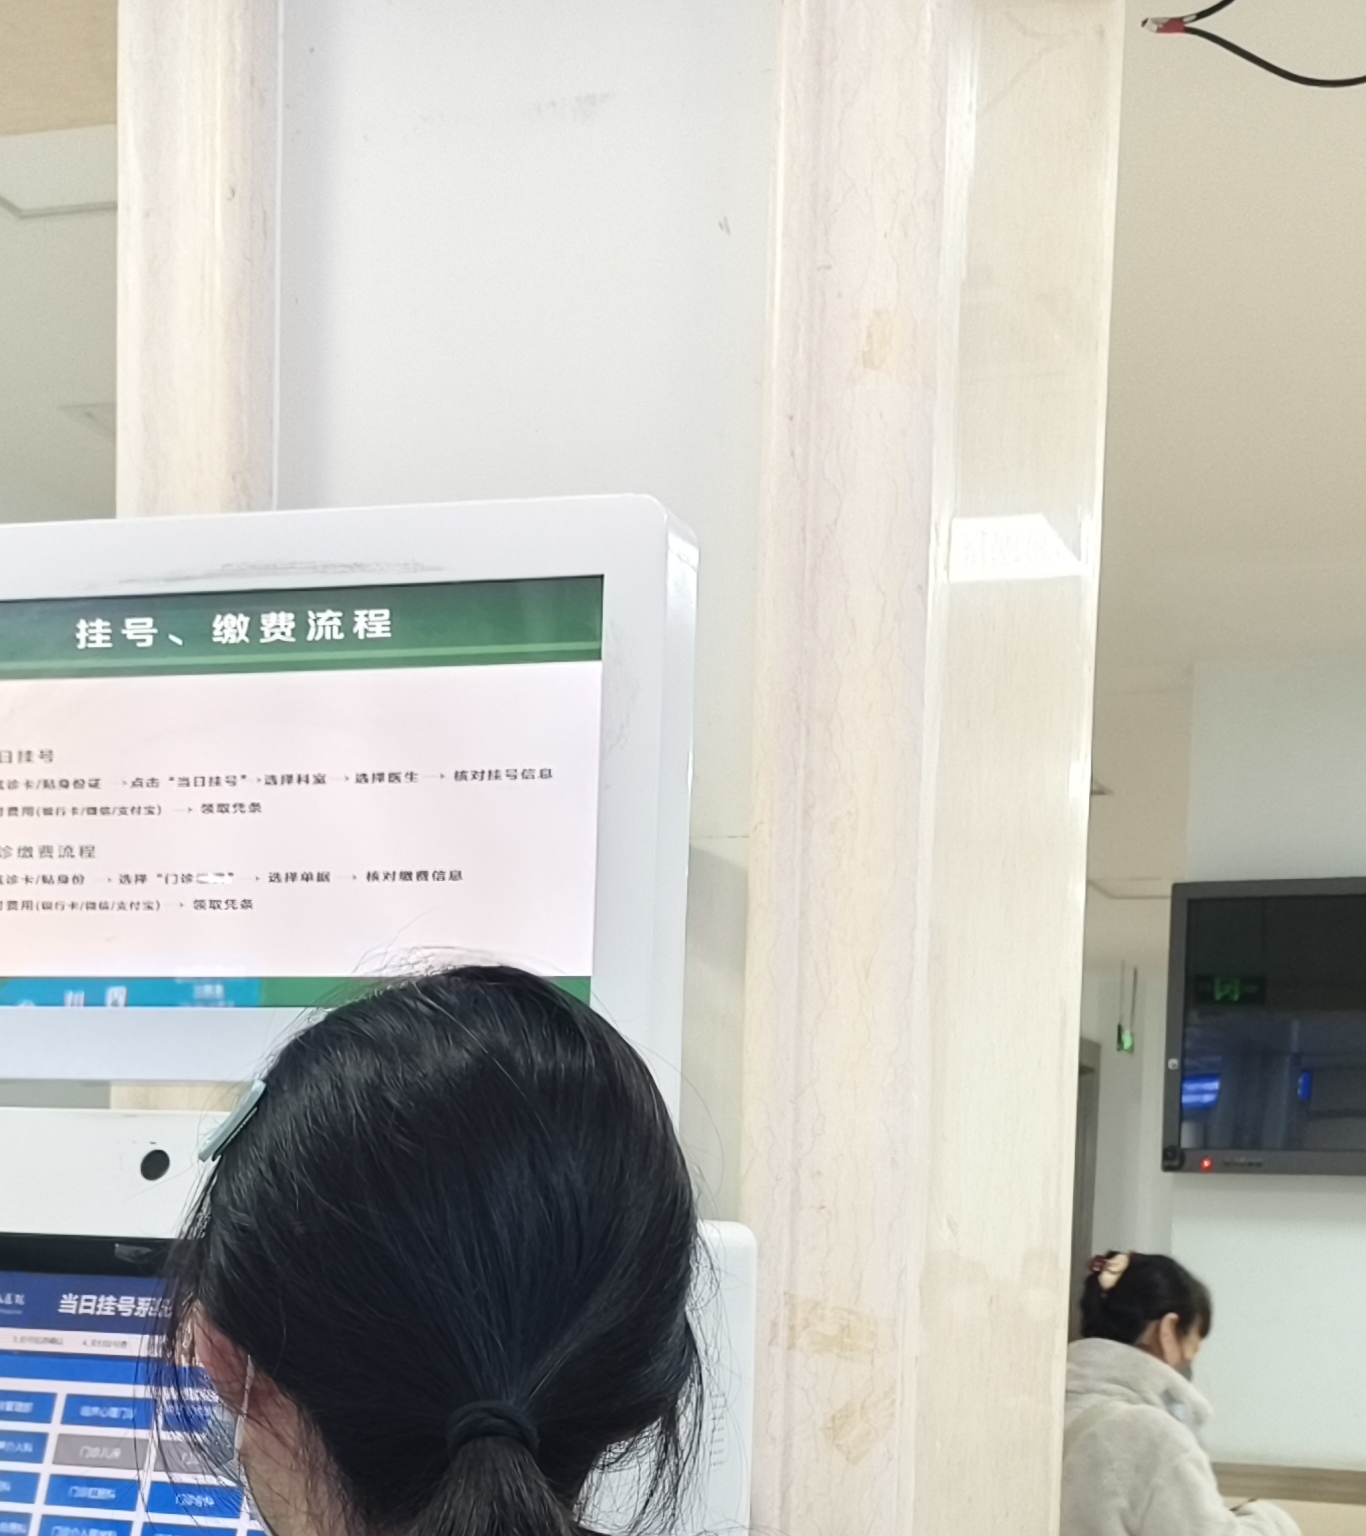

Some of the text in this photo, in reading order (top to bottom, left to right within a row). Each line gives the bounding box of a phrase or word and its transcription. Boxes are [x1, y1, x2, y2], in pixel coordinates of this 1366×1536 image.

[75, 608, 394, 651] 挂号、缴费流程
[264, 773, 328, 786] 选择科室
[354, 771, 419, 784] 选择医生
[453, 768, 554, 782] 核对挂号信息
[200, 802, 263, 815] 领取凭条
[365, 869, 464, 883] 核对缴费信息
[192, 898, 254, 912] 领取凭条
